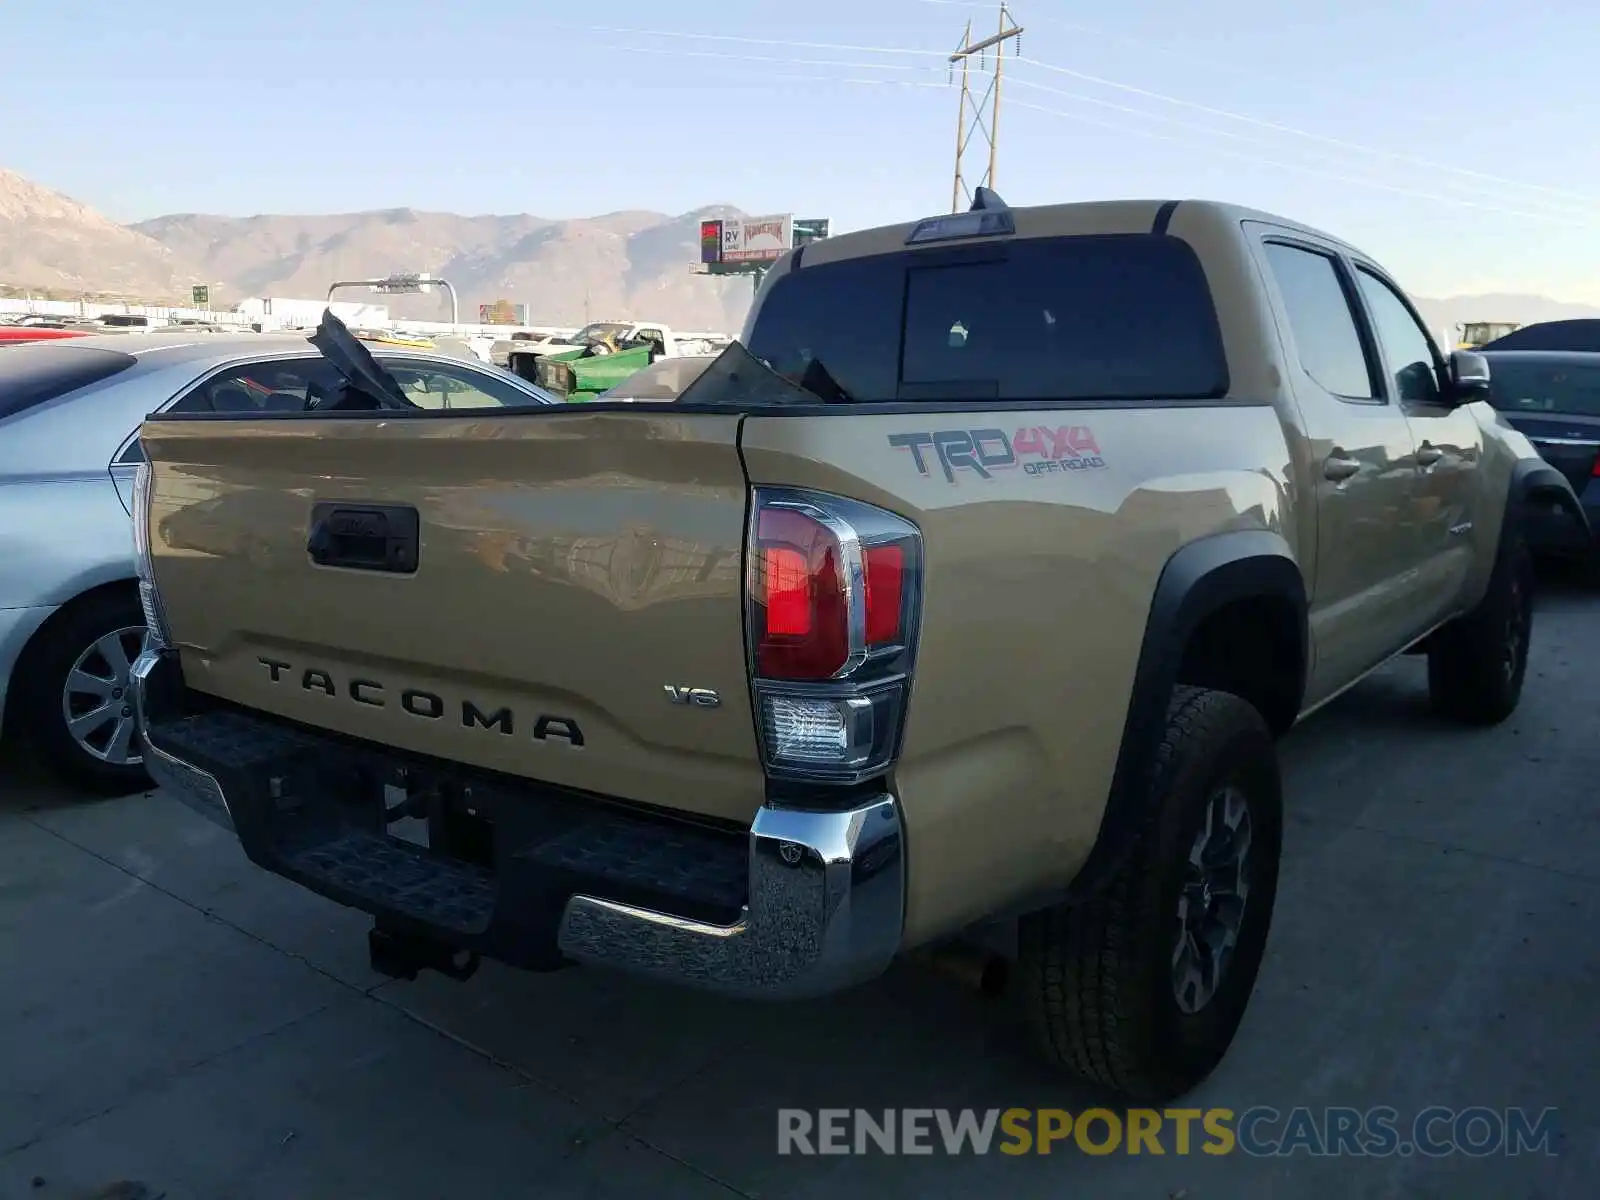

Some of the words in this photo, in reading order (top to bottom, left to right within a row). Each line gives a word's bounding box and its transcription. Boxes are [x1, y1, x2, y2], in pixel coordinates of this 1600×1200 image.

[888, 429, 1017, 484] TRD
[256, 656, 586, 748] TACOMA
[663, 684, 720, 706] V6
